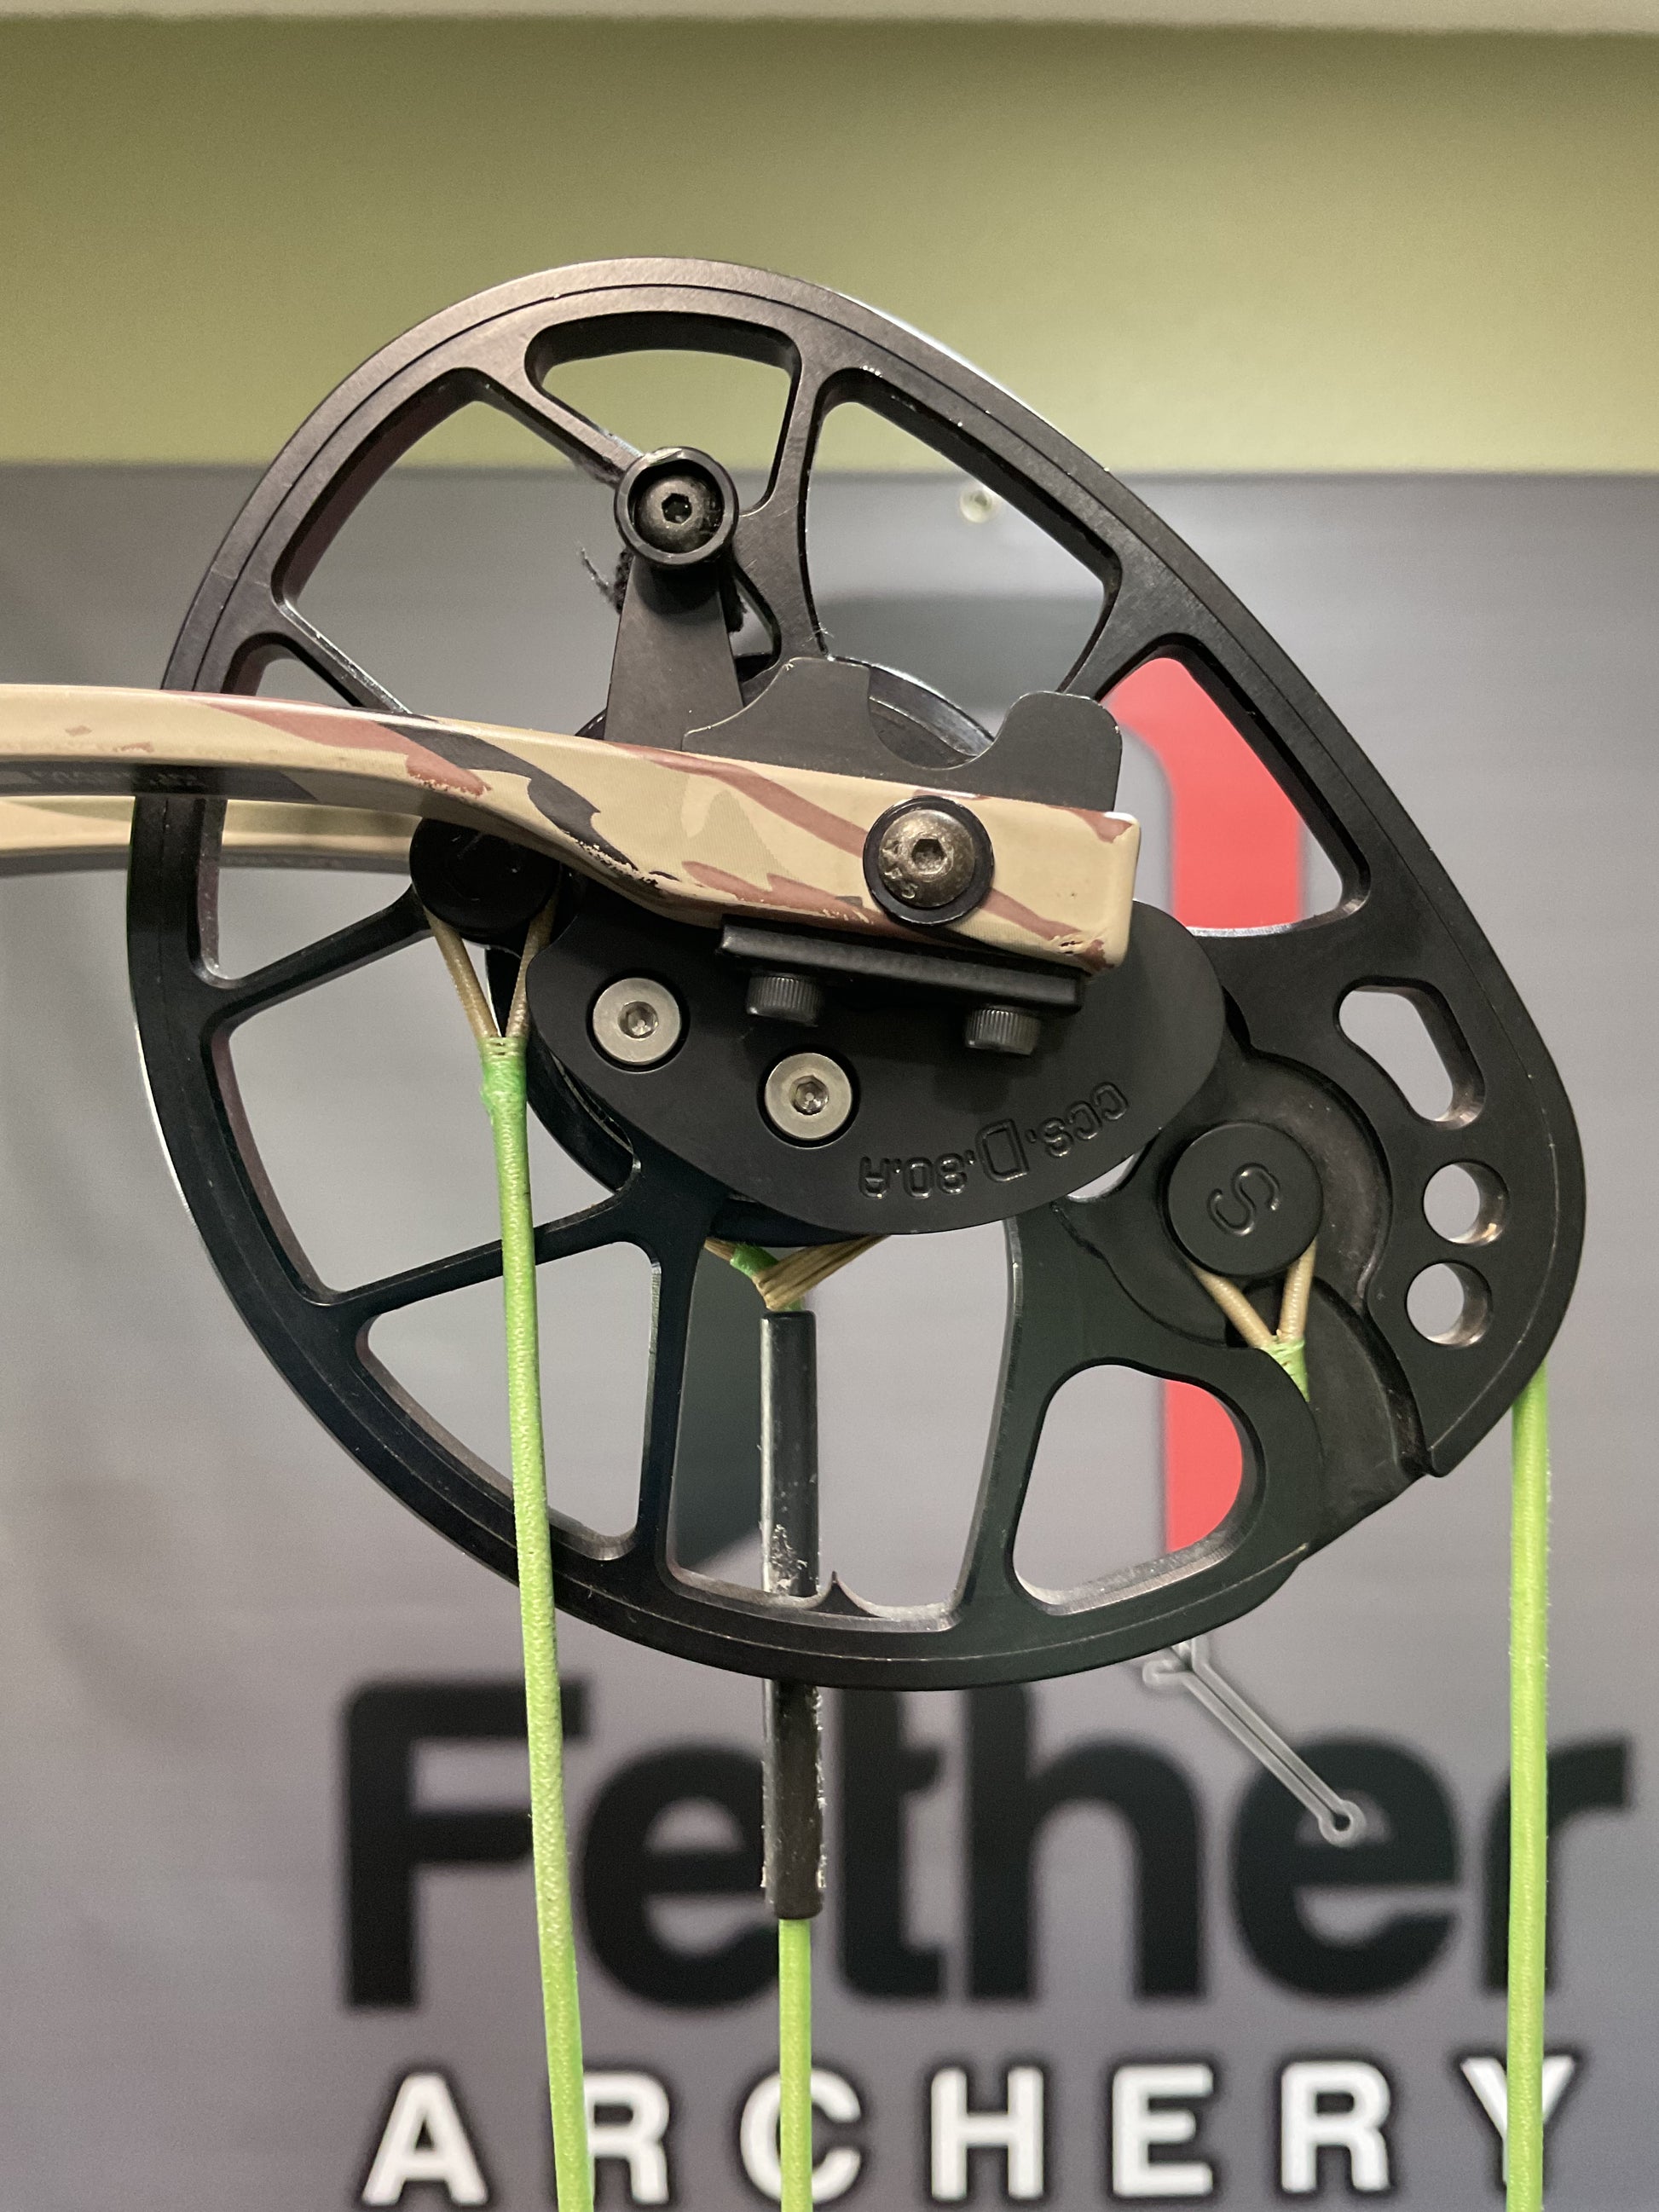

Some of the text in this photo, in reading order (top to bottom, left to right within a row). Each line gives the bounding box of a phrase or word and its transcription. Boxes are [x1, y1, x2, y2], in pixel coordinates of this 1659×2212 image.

[1207, 1162, 1280, 1237] S
[343, 1679, 1630, 2010] Fether
[361, 2054, 1575, 2206] ARCHERY
